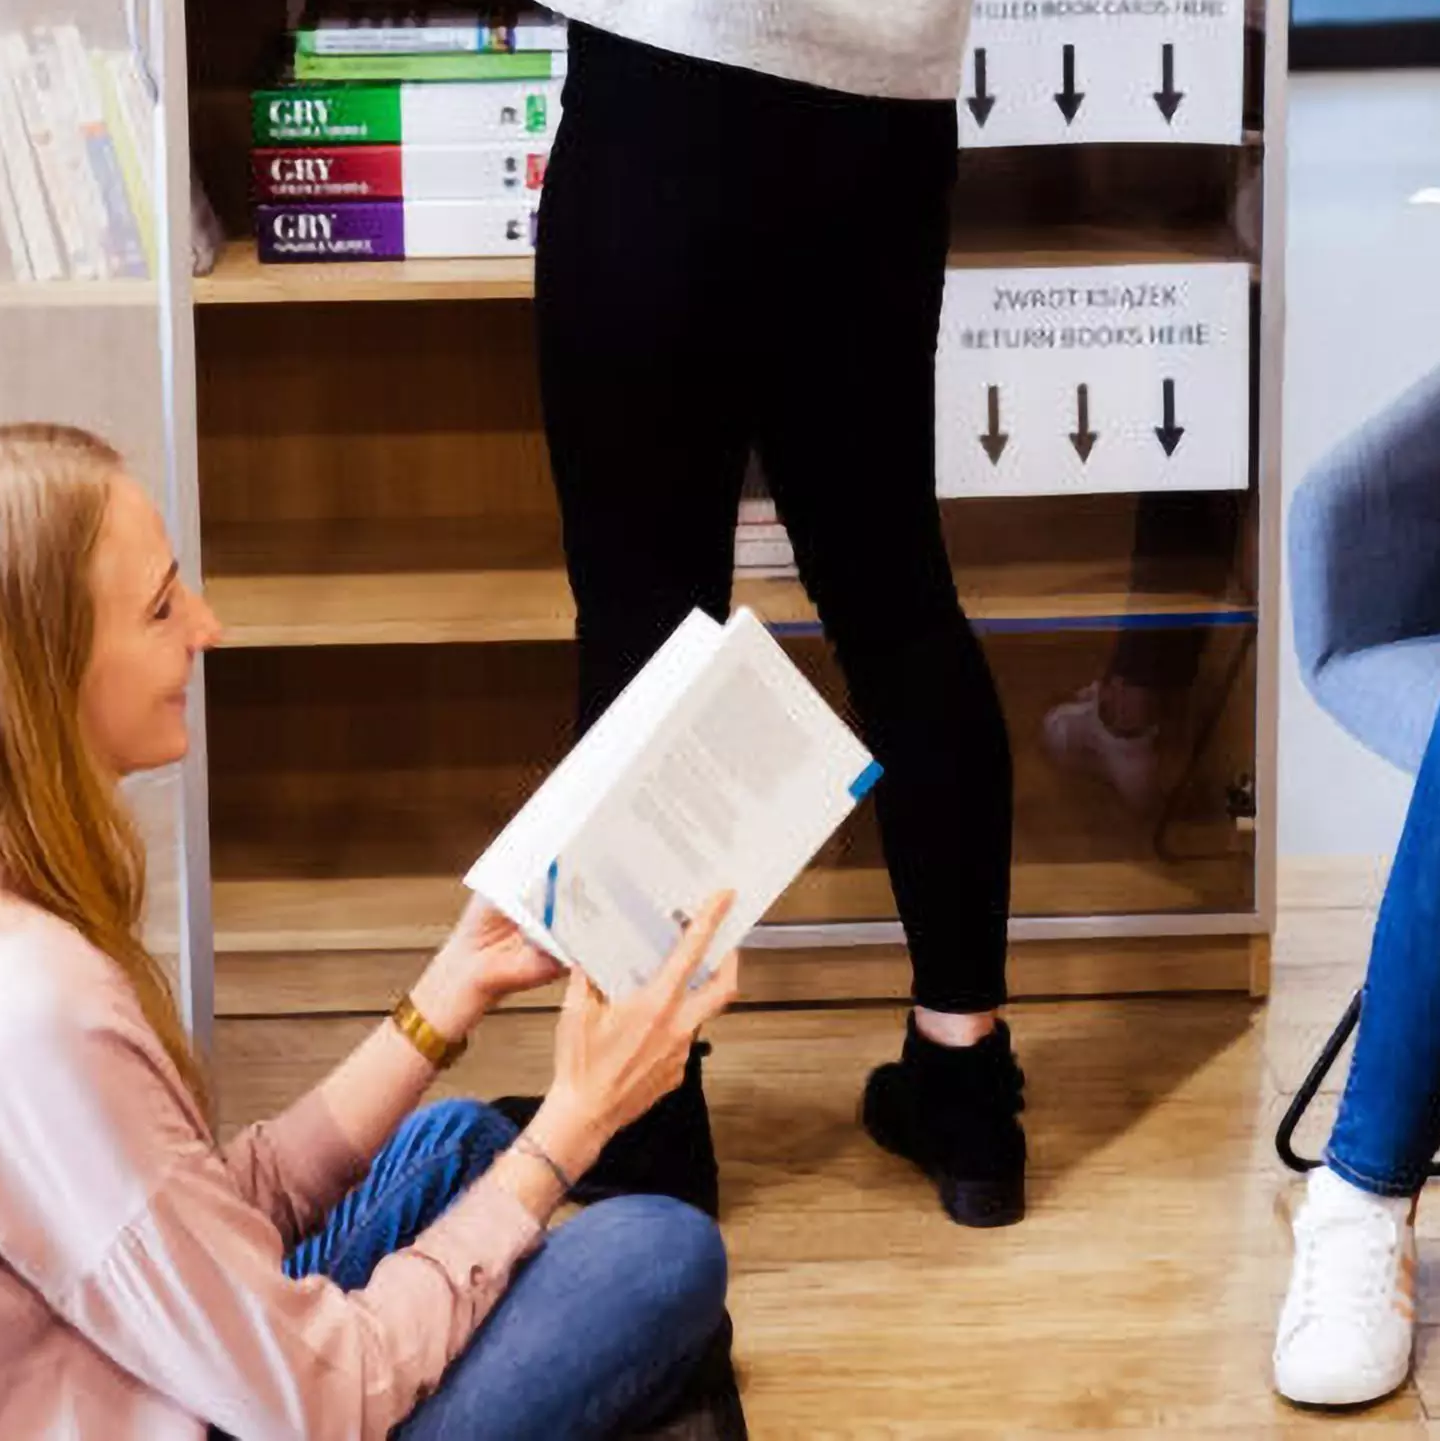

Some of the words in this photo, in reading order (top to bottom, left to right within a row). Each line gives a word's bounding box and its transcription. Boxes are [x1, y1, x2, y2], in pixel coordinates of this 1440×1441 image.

[993, 283, 1079, 311] ZWROT
[961, 326, 1055, 350] RETURN
[1060, 325, 1143, 349] BOOKS
[1149, 321, 1211, 347] HERE
